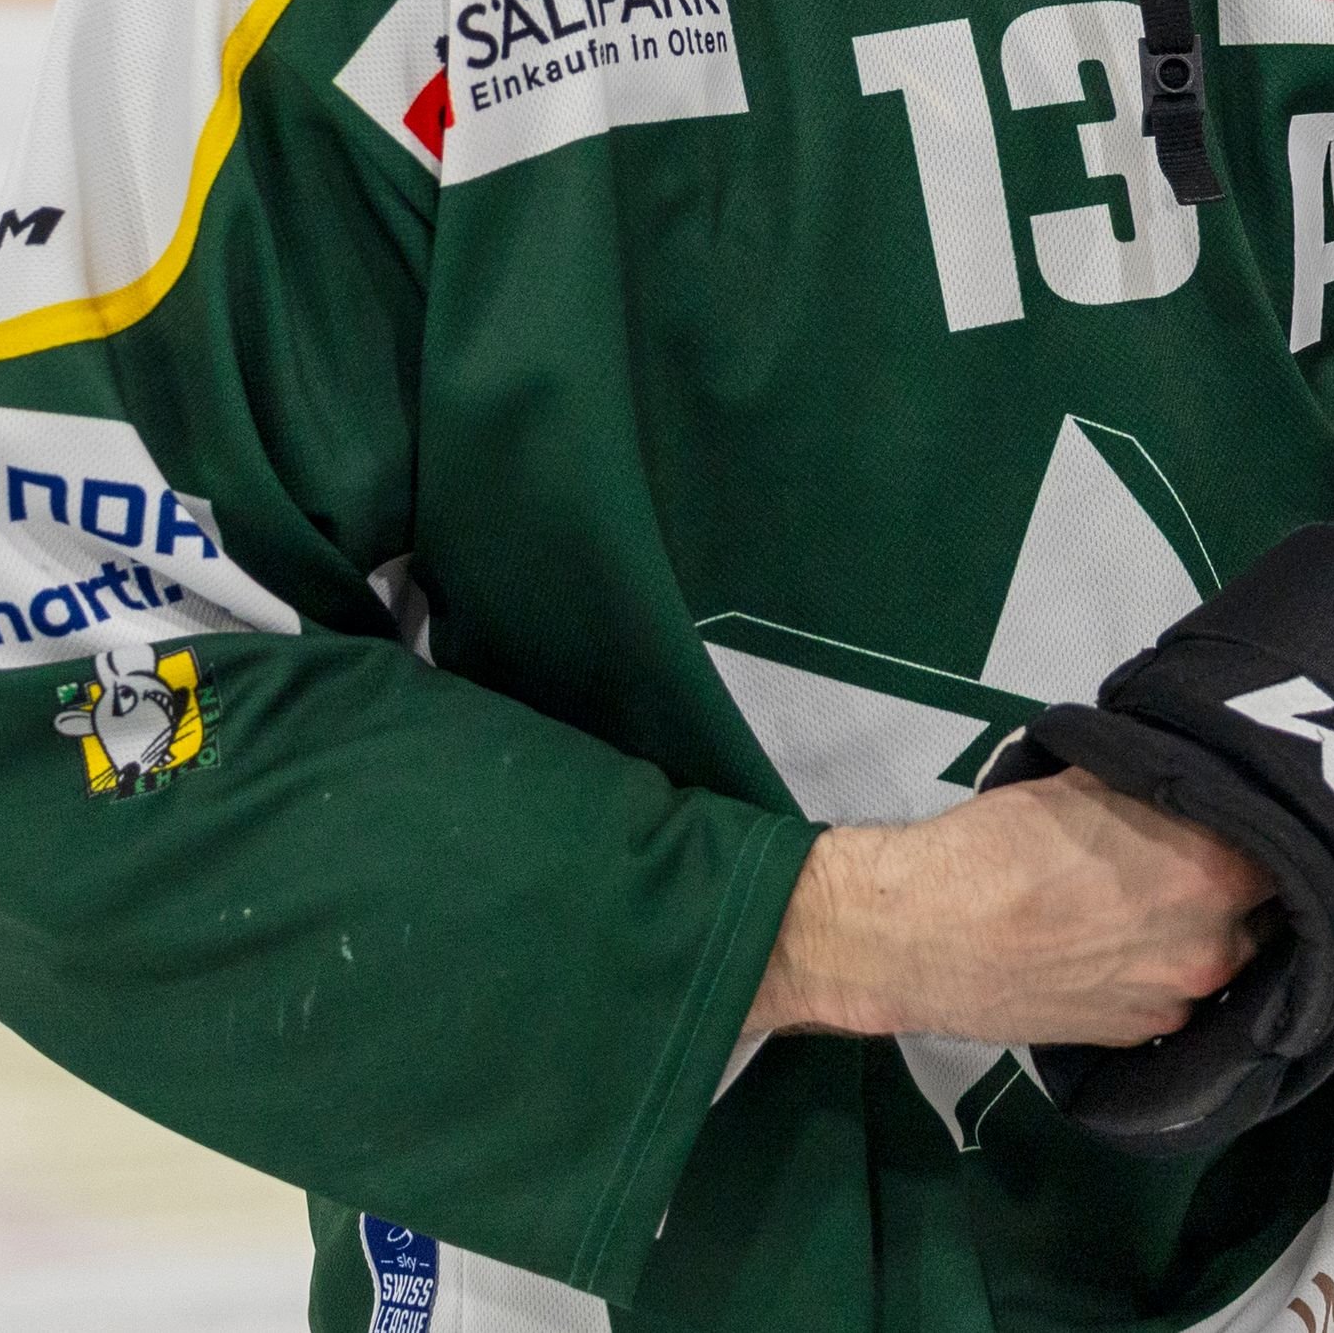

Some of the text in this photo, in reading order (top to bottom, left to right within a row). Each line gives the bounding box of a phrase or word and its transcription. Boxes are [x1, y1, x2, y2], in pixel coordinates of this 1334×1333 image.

[632, 33, 658, 62] in
[668, 28, 728, 57] Olten
[852, 0, 1201, 333] 13
[396, 1253, 417, 1273] sky
[382, 1273, 434, 1307] SWISS
